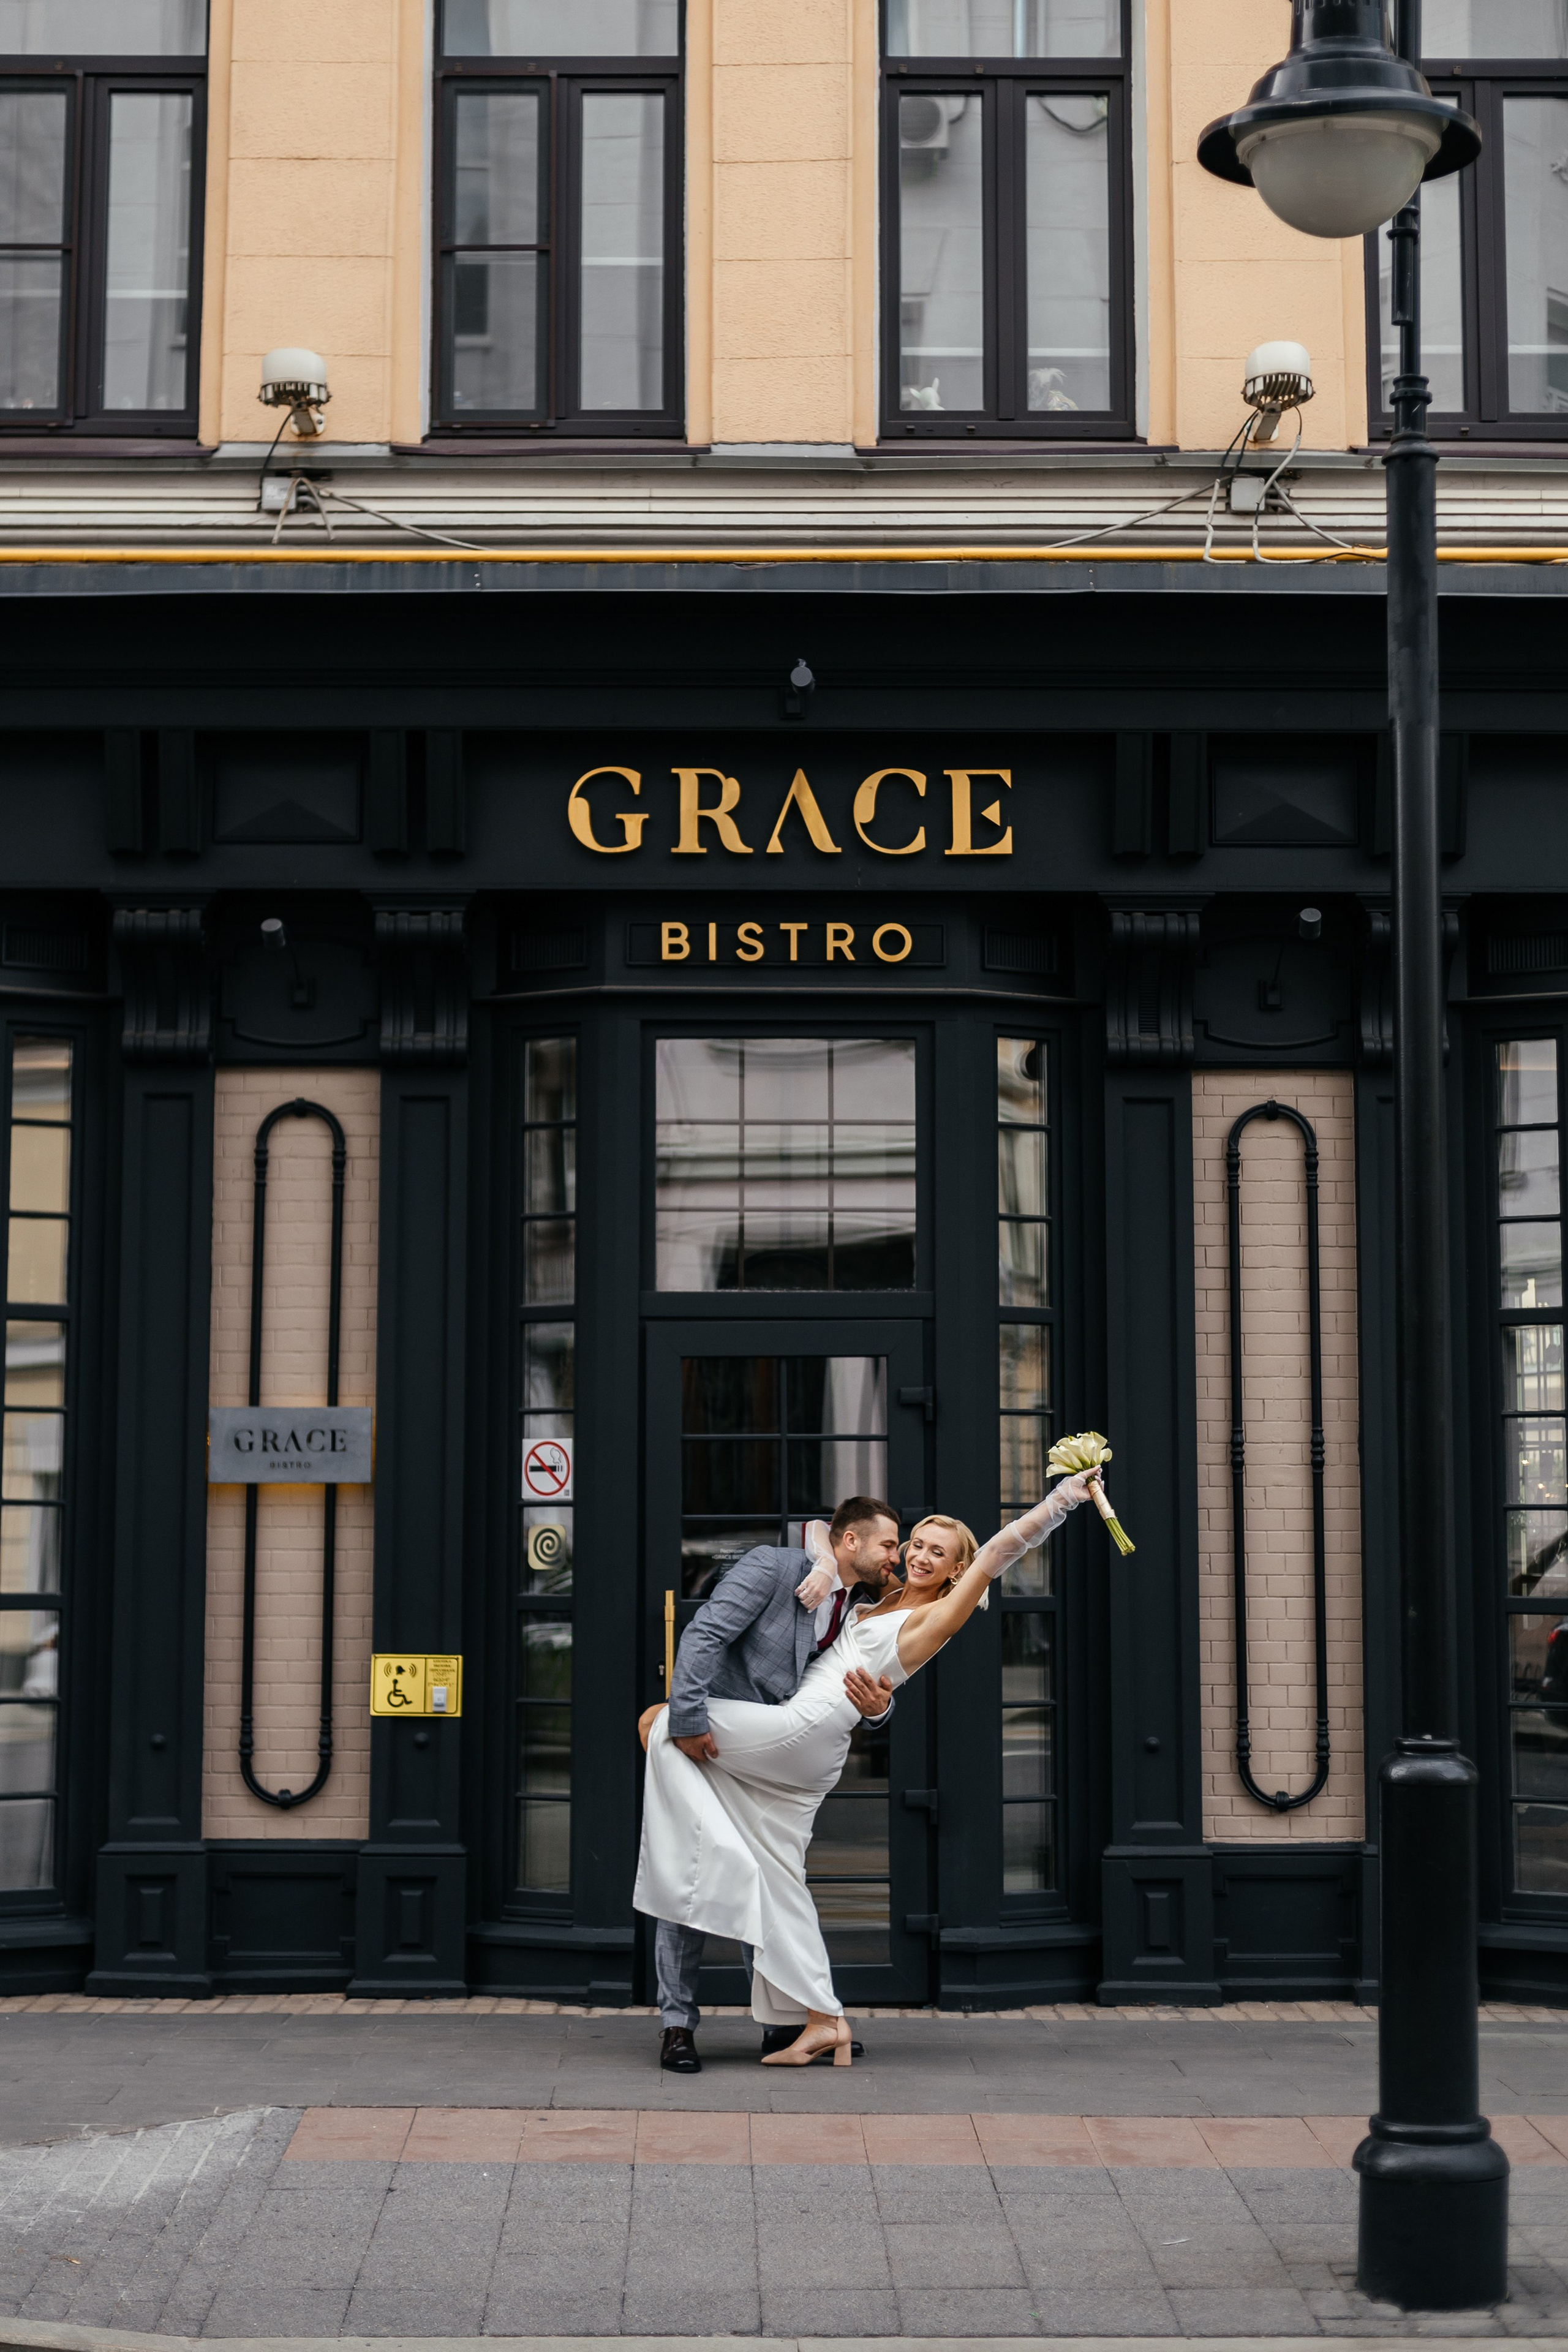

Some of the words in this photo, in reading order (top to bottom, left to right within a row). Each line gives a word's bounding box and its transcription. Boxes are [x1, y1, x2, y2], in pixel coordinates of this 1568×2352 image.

[568, 766, 1013, 855] GRACE
[661, 922, 913, 962] BISTRO
[233, 1428, 347, 1453] GRACE
[269, 1461, 312, 1469] BISTRO
